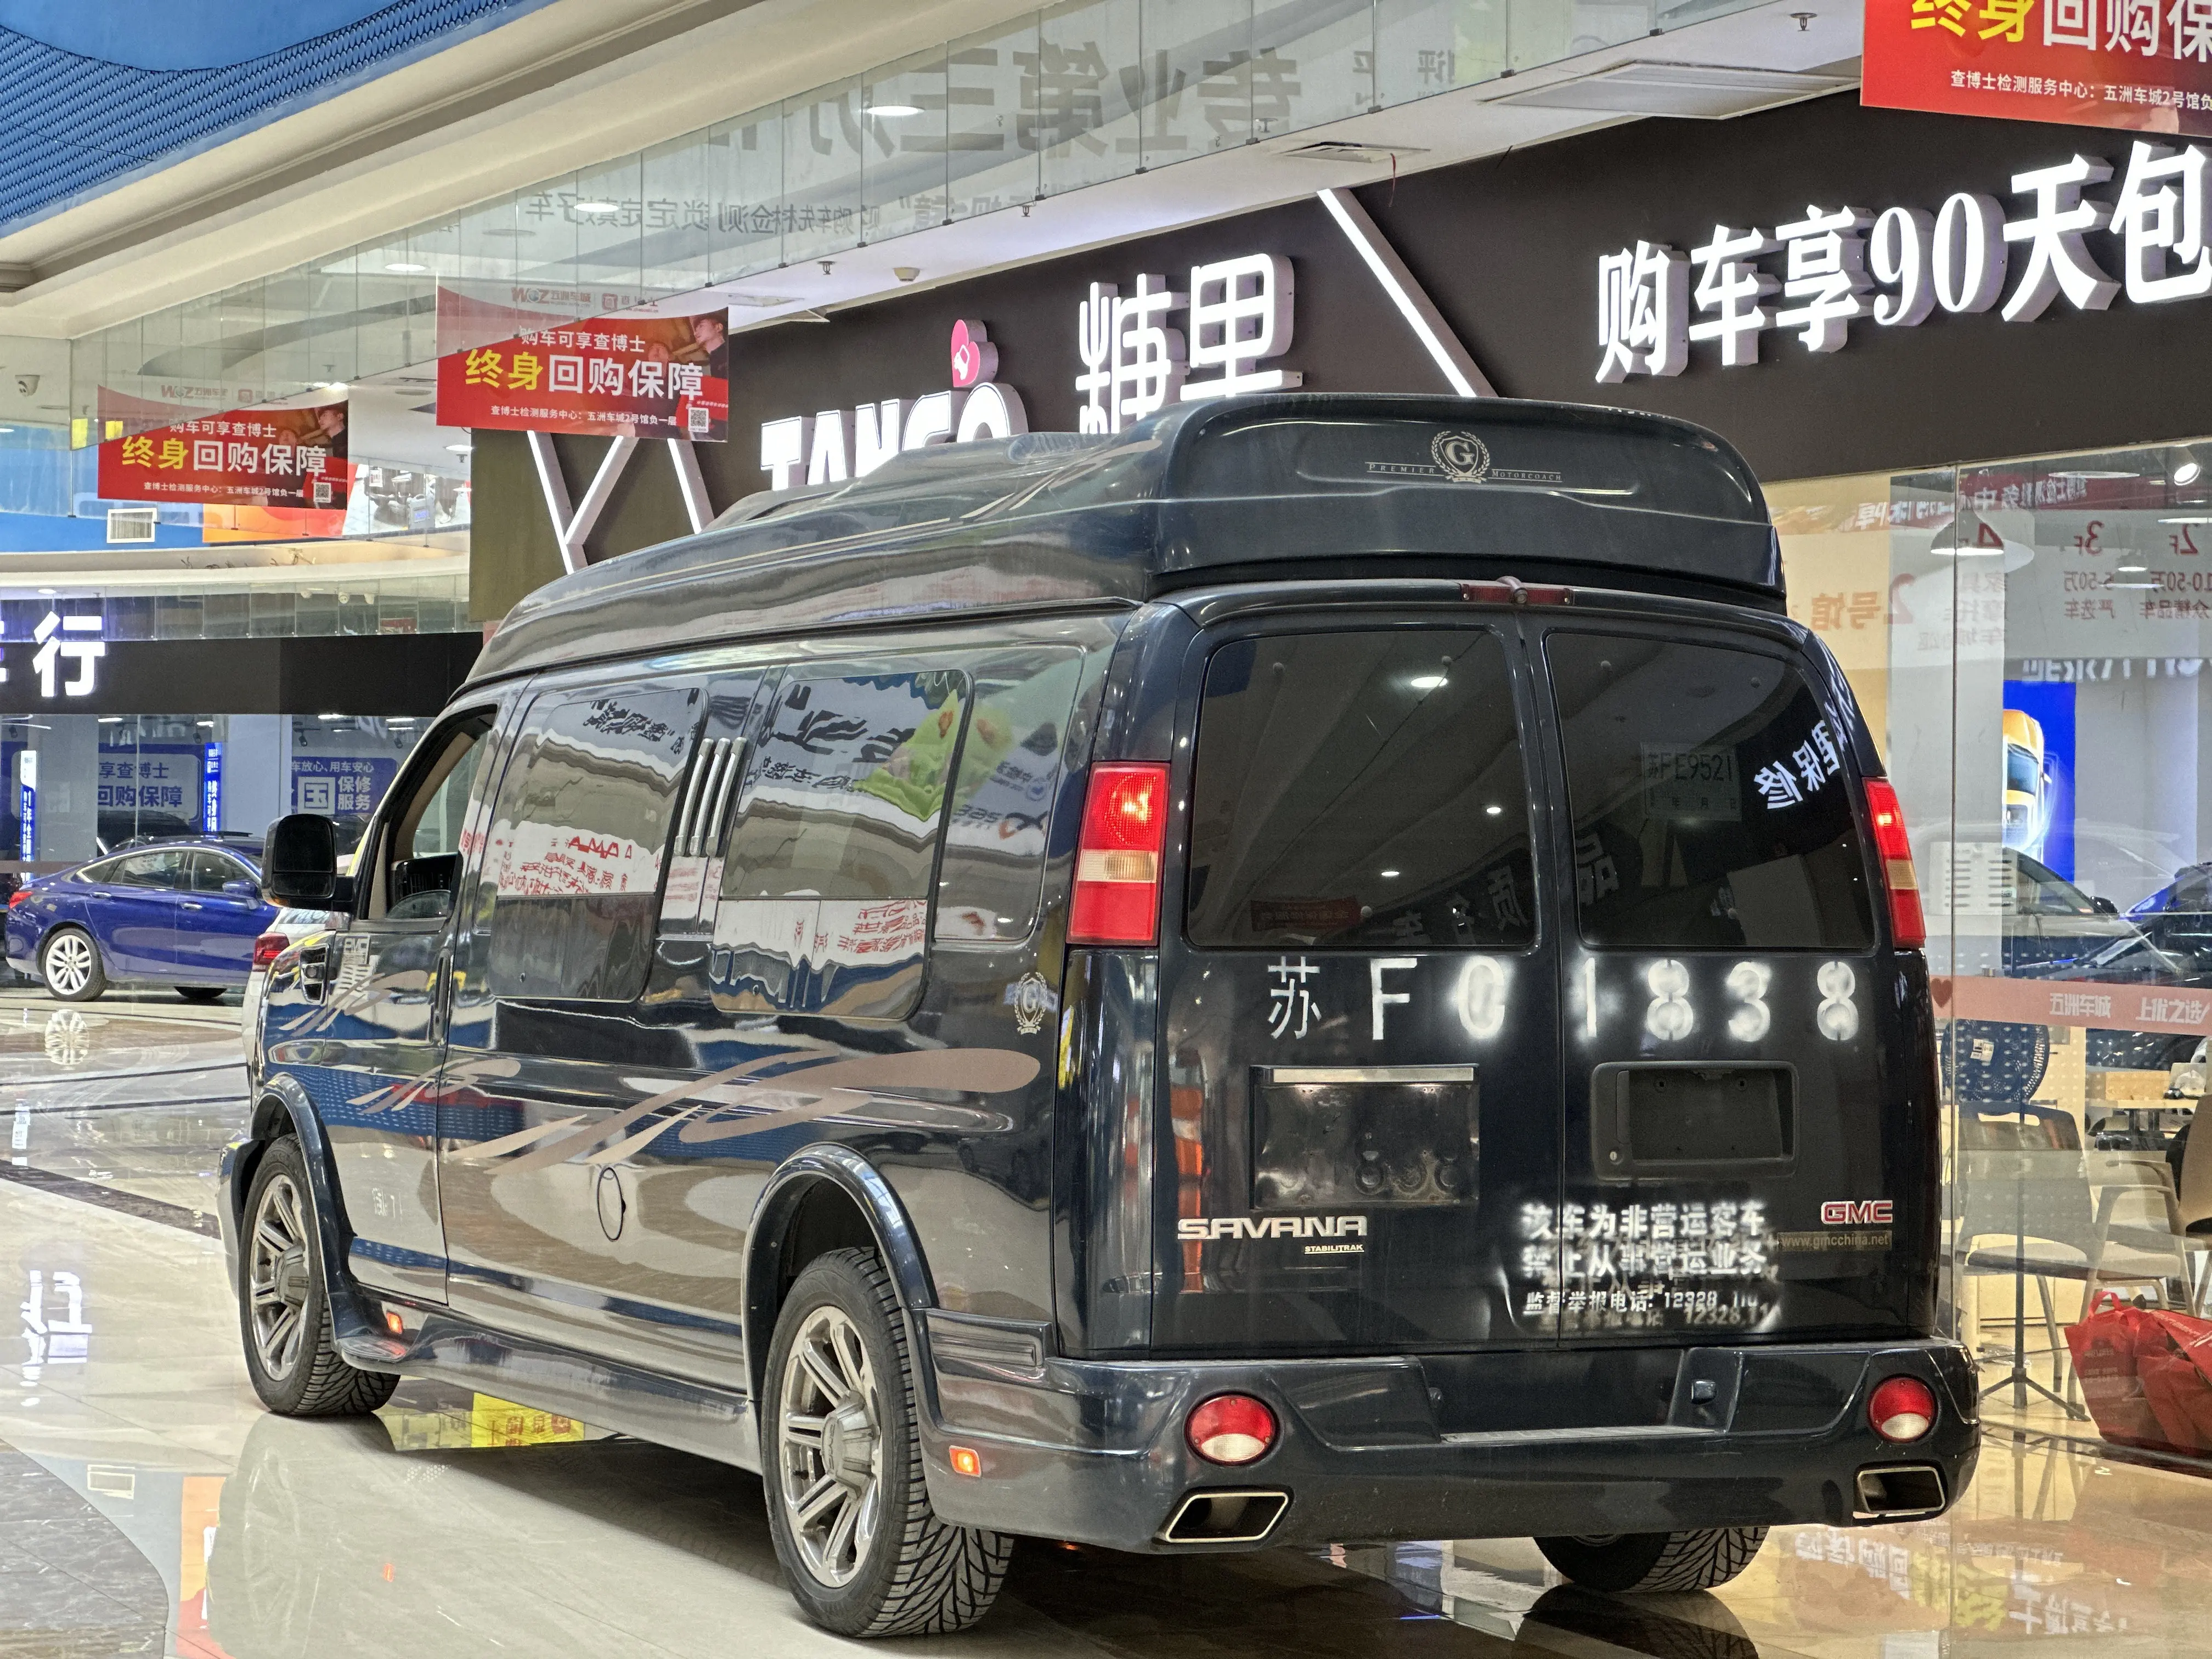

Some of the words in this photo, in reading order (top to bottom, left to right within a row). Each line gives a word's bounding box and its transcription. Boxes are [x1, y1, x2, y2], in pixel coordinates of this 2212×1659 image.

[520, 326, 646, 352] 购车可享查博士
[465, 348, 703, 399] 终身回购保障
[170, 419, 276, 438] 购车可享查博士
[121, 436, 326, 477] 终身回购保障
[1369, 464, 1435, 475] PREMIER
[1492, 471, 1562, 481] MOTORCOACH
[0, 611, 106, 697] 行
[338, 776, 371, 793] 保修
[338, 794, 371, 811] 服务
[2049, 992, 2112, 1019] 五洲车城
[1821, 1199, 1893, 1225] GMC
[1177, 1215, 1368, 1240] SAVANA
[1304, 1244, 1364, 1252] STABILITRAK
[1782, 1233, 1889, 1250] www.gmcchina.net
